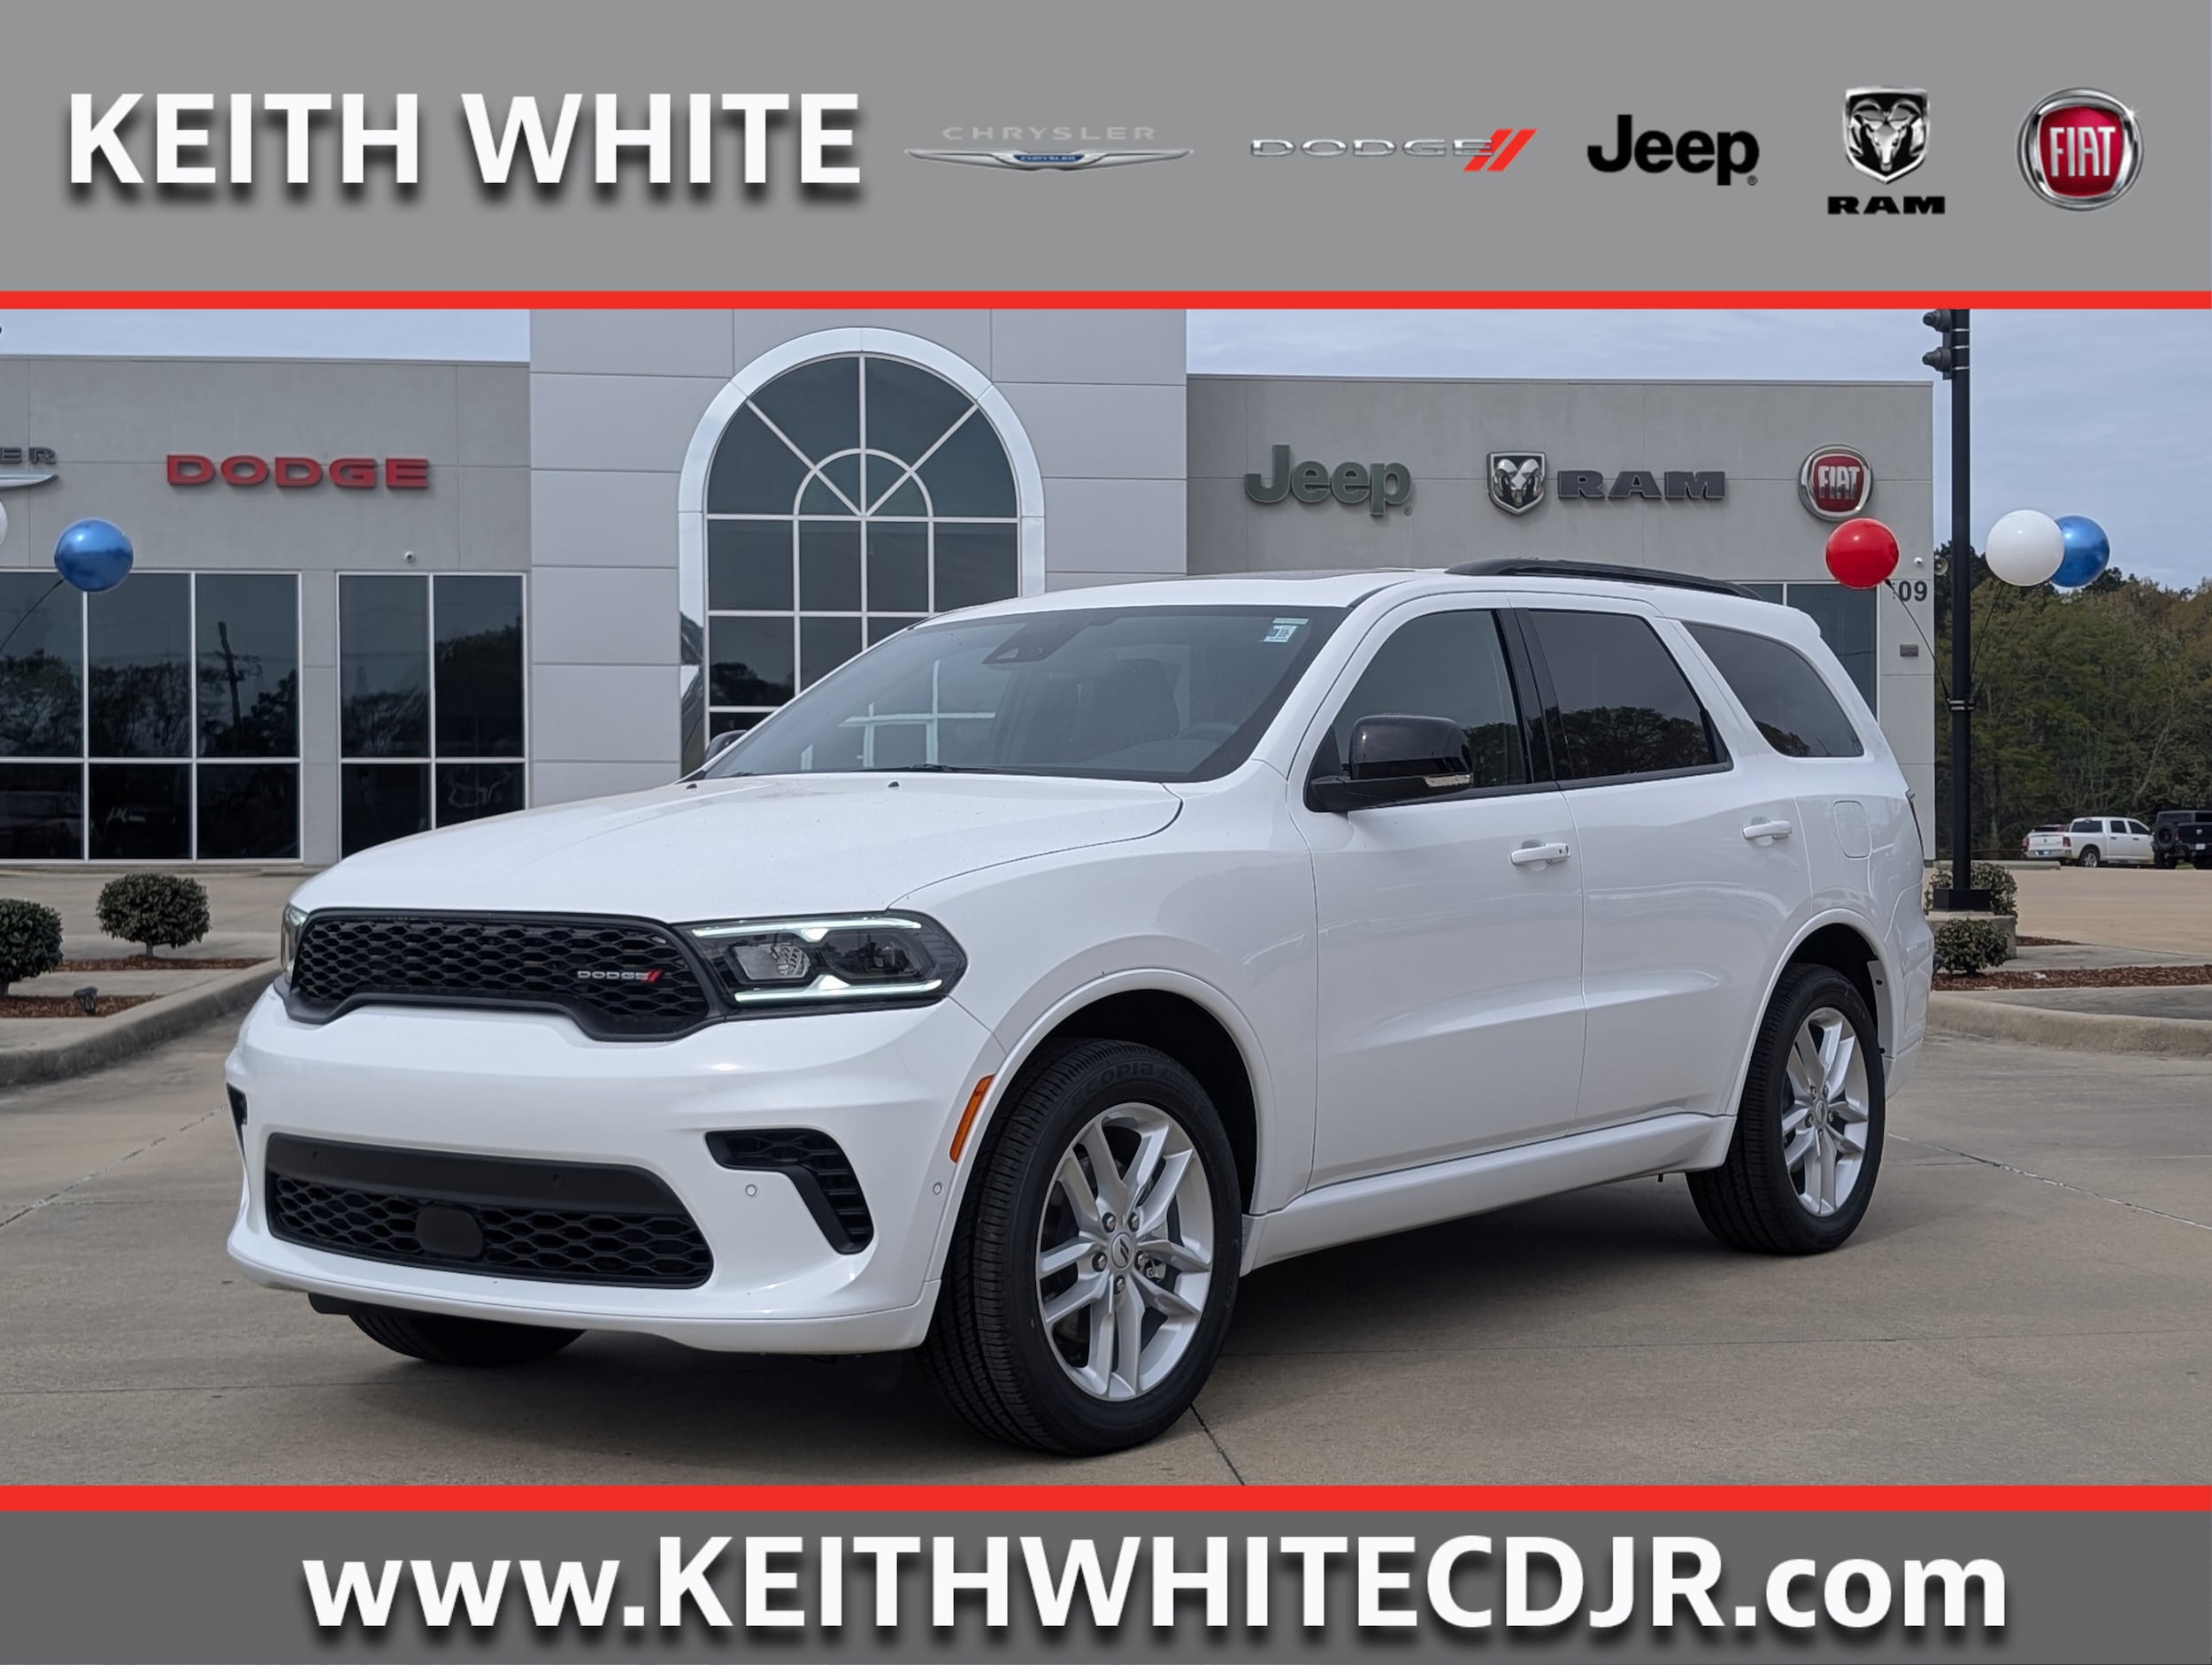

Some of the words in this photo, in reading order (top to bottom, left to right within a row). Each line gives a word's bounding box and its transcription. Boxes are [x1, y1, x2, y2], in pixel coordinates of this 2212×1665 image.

[166, 454, 430, 488] DODGE
[1244, 444, 1413, 517] Jeep
[1556, 470, 1726, 500] RAM
[1817, 465, 1860, 500] FIAT
[578, 971, 649, 979] DODGE
